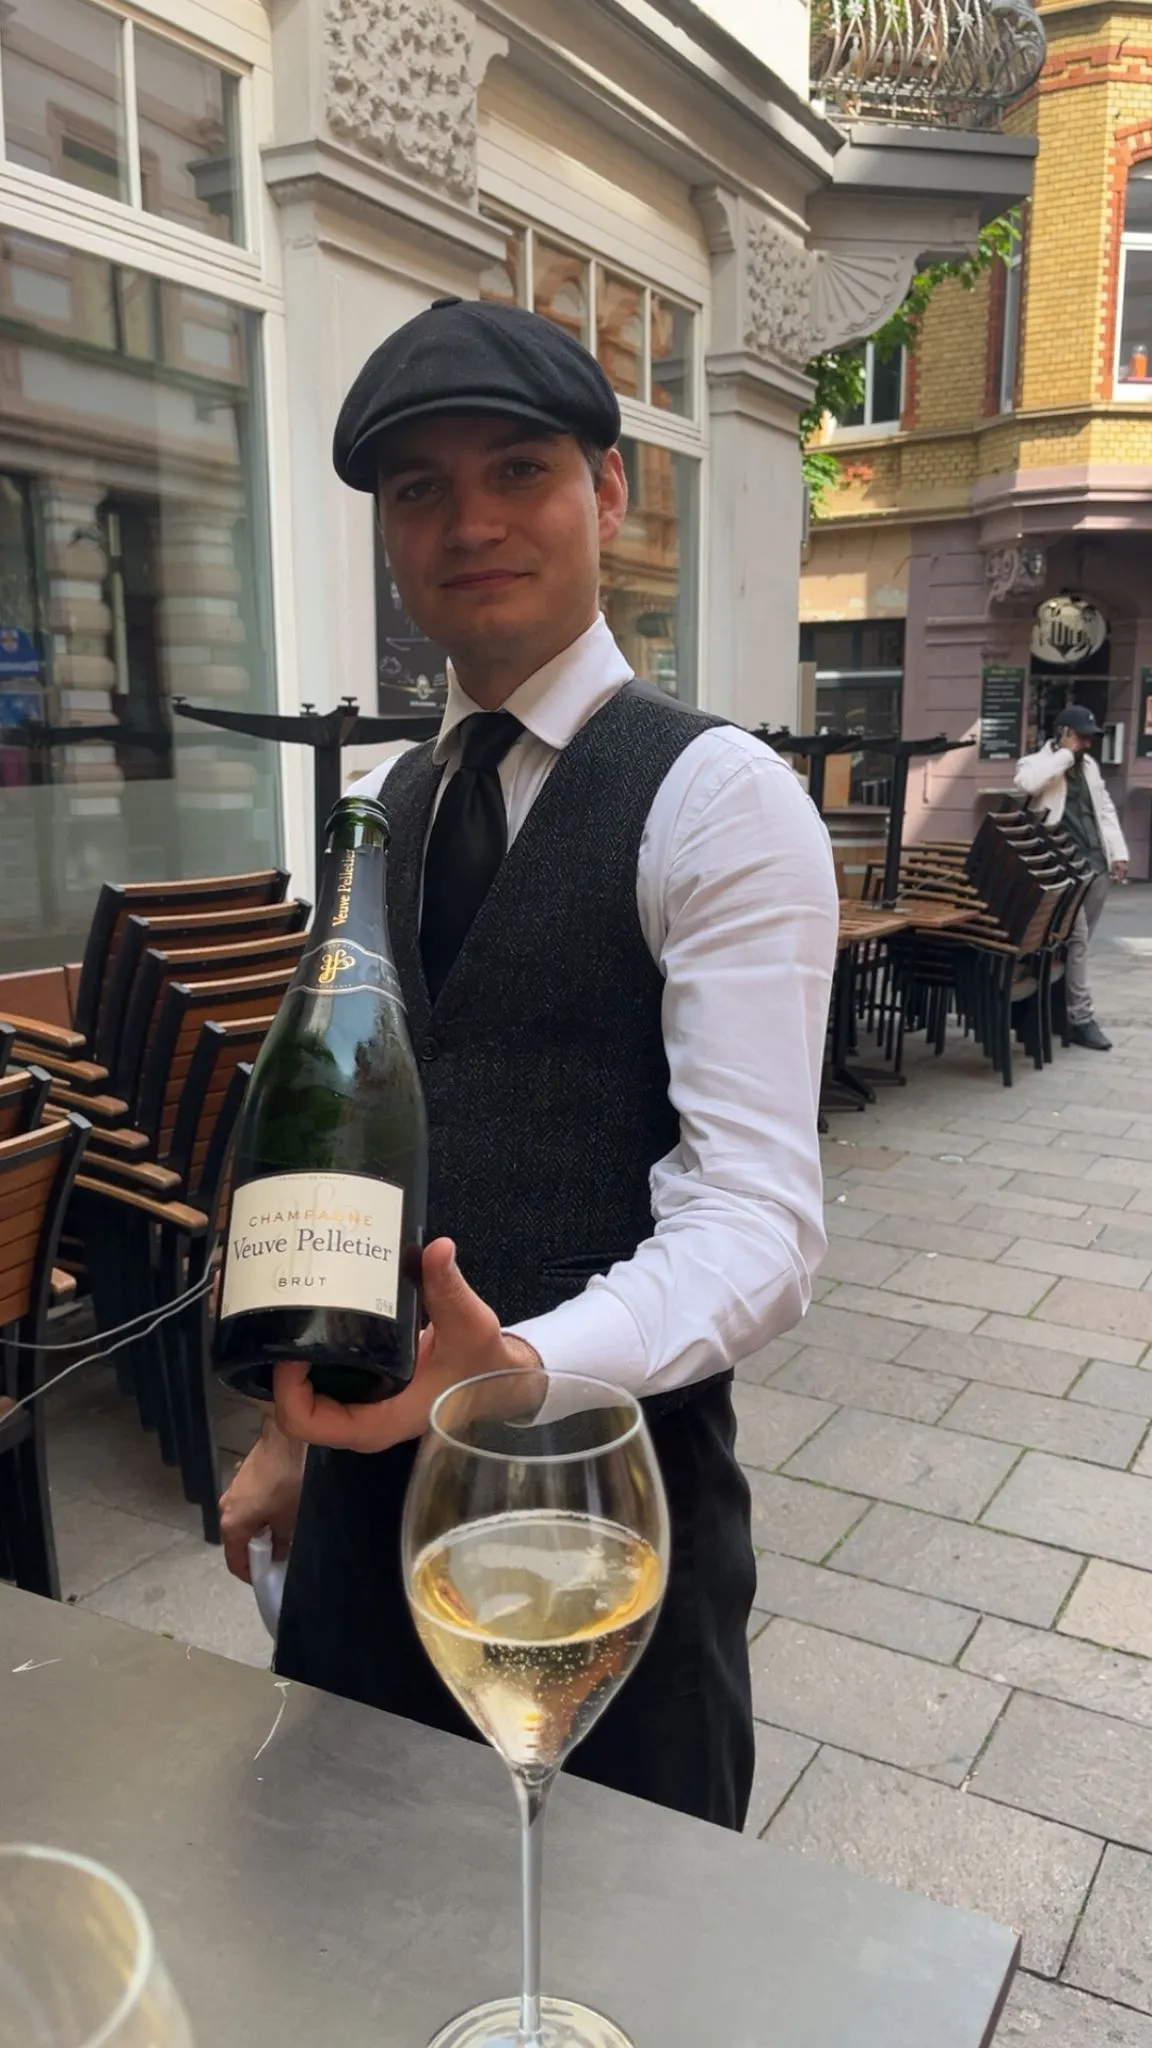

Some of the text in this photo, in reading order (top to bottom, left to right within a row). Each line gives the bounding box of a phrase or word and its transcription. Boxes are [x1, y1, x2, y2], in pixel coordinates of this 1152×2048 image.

[337, 849, 356, 893] Pelletier
[332, 894, 350, 927] Veuve
[248, 1209, 374, 1228] CHAMPAGNE
[233, 1228, 393, 1262] Veuve Pelletier
[278, 1276, 327, 1288] BRUT
